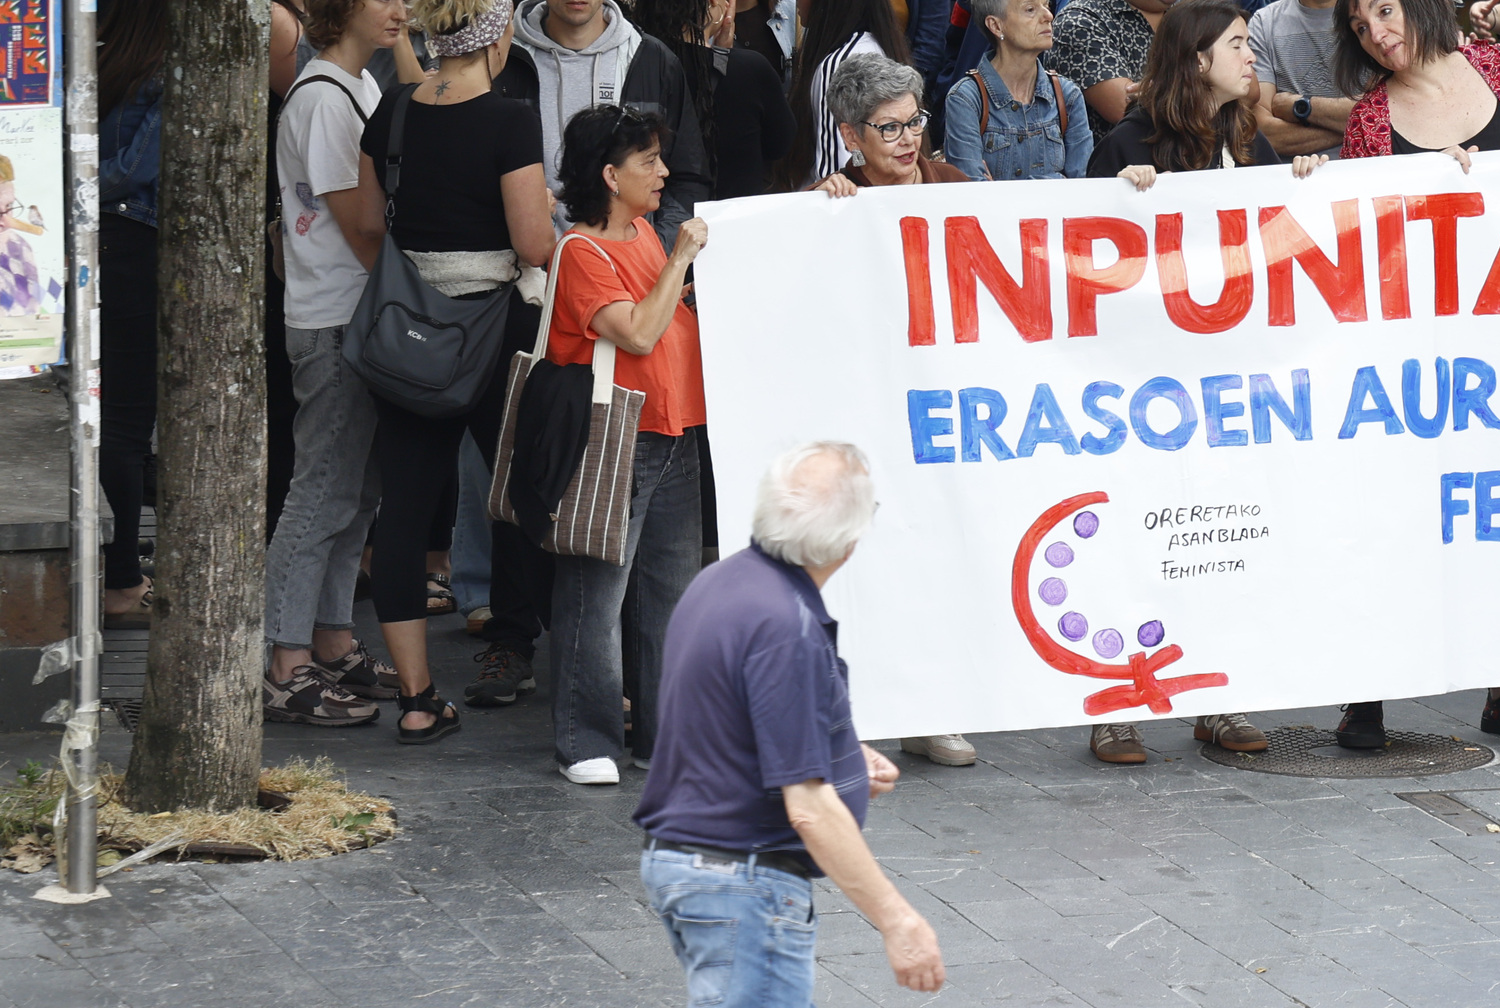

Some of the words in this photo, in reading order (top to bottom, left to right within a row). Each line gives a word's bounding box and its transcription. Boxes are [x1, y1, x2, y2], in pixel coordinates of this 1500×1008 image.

[907, 368, 1313, 465] ERASOEN
[1144, 504, 1261, 530] ORERETAKO
[1168, 526, 1270, 551] ASANBLADA
[1161, 559, 1246, 580] FEMINISTA
